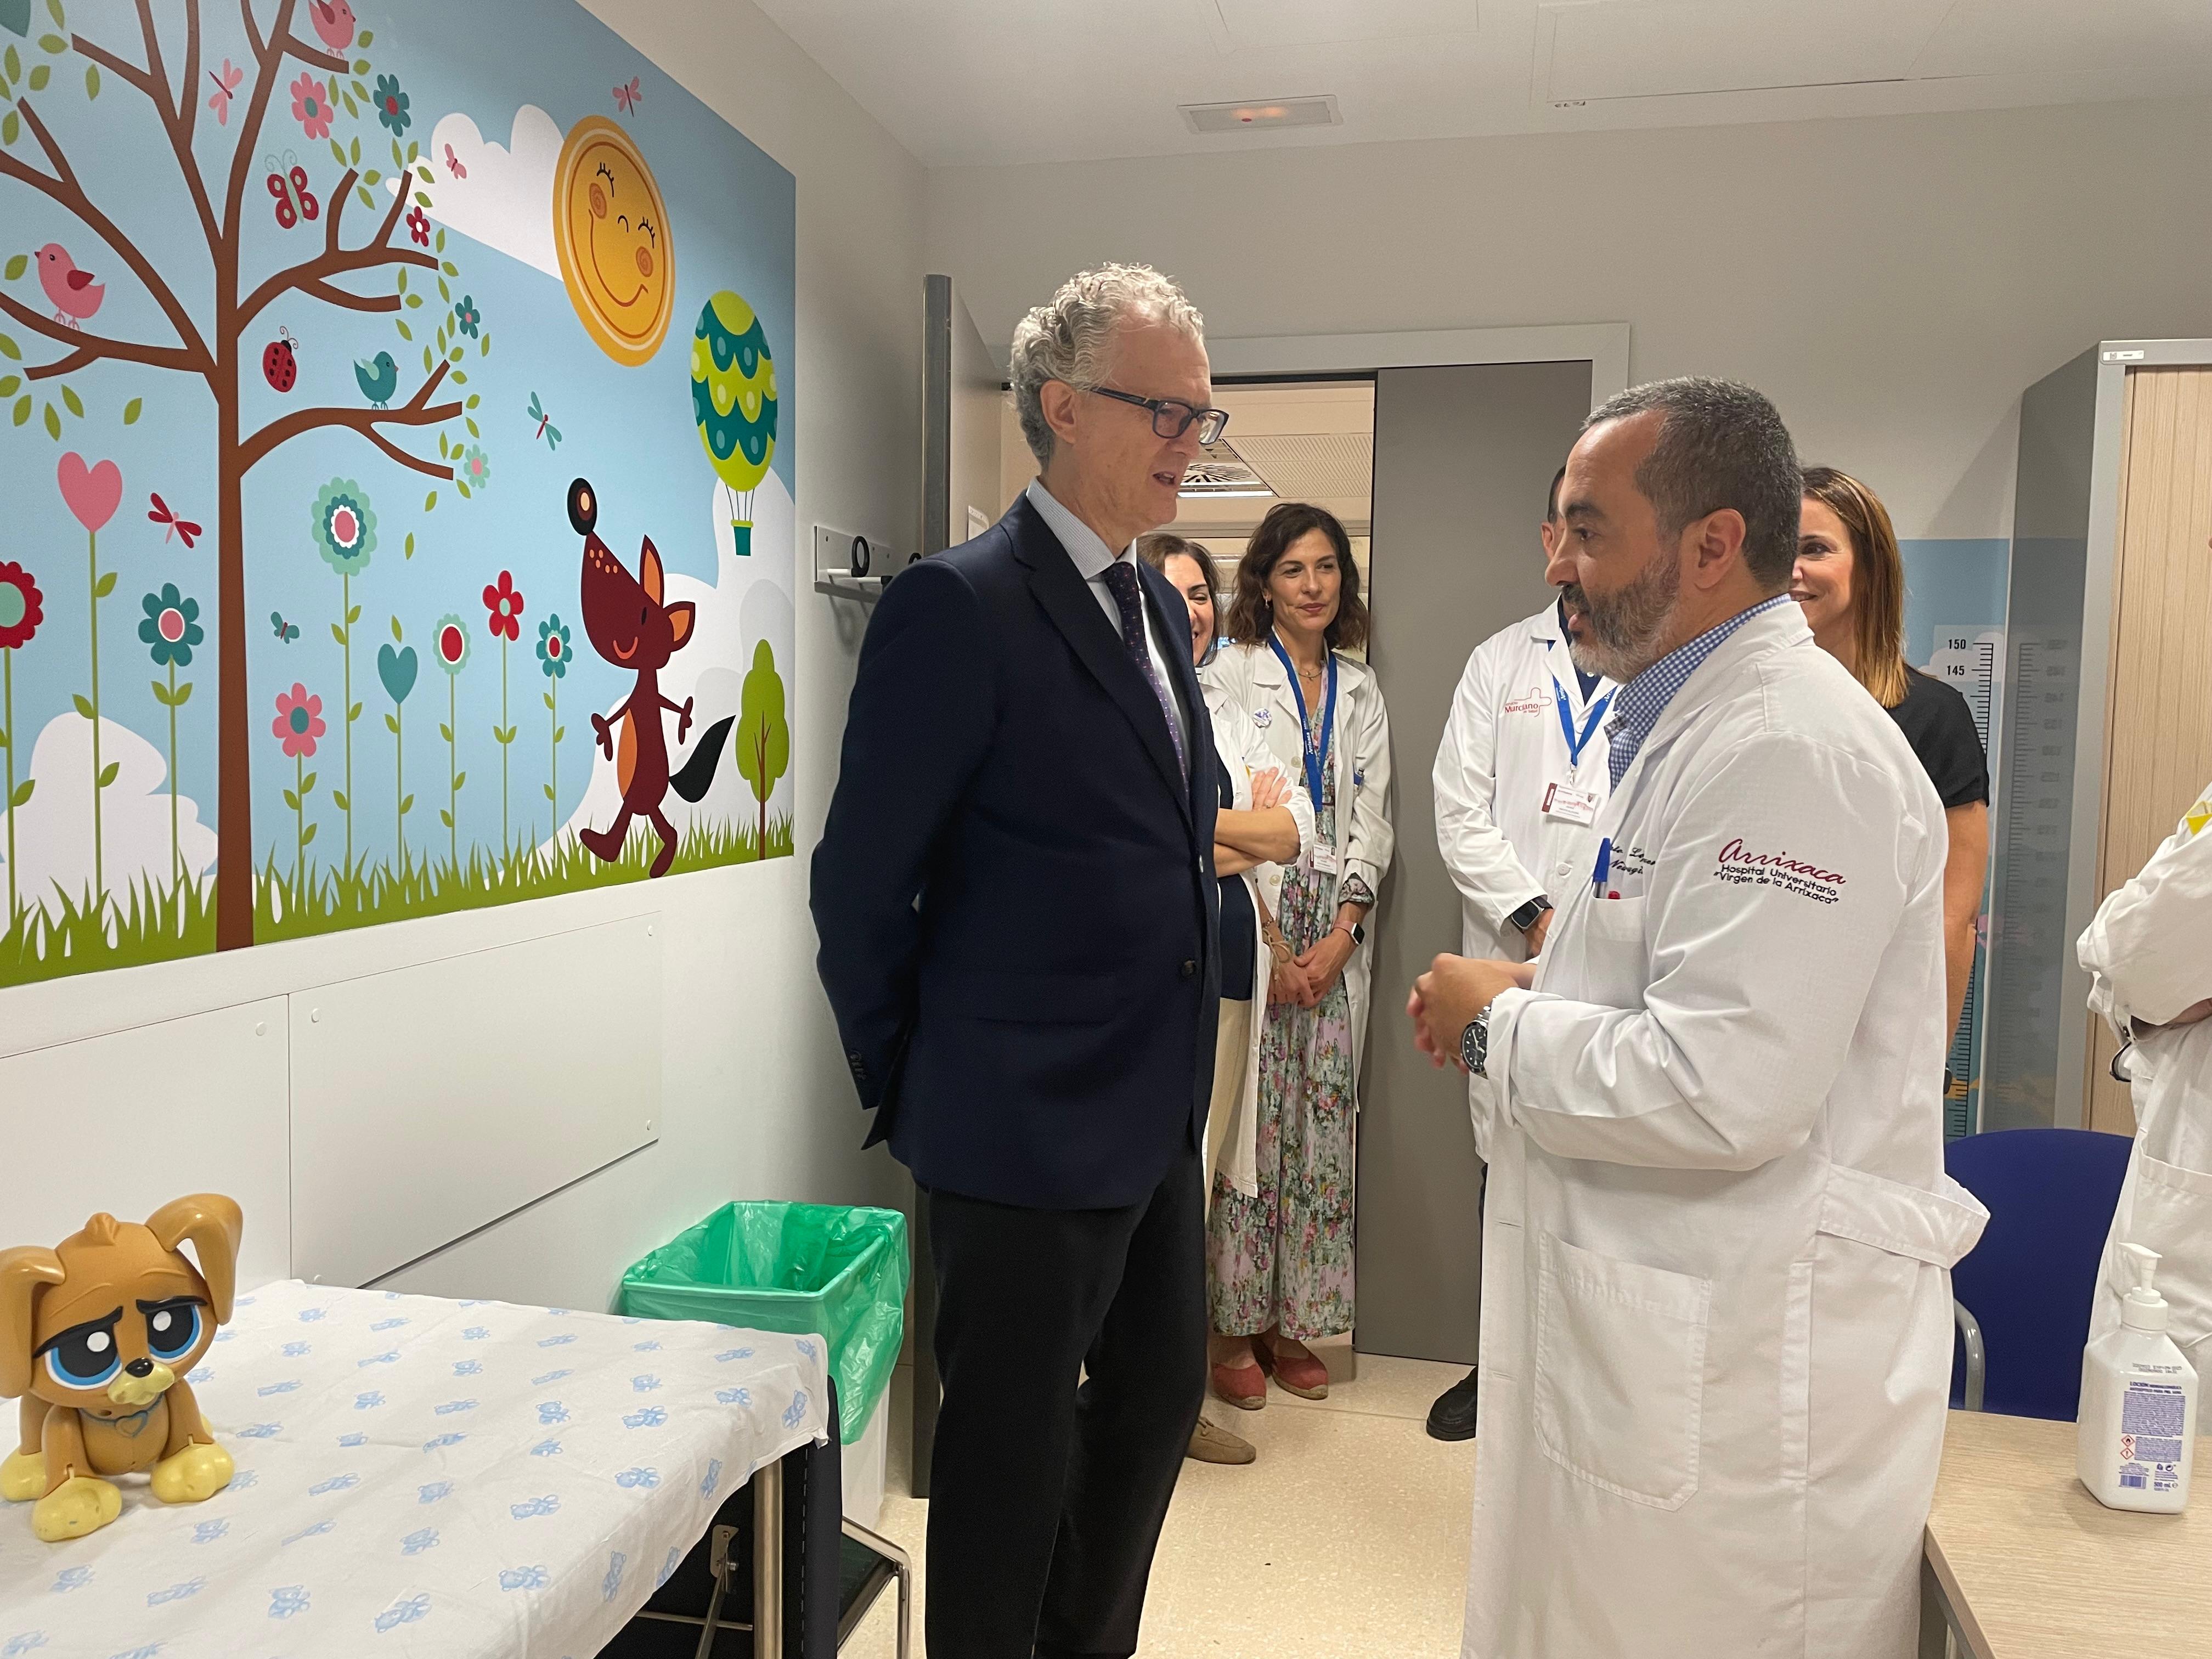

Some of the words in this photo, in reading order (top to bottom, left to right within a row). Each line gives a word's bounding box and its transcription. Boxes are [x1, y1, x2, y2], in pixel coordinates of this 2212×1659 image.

[1949, 639, 1966, 649] 150
[1947, 665, 1965, 675] 145
[1718, 838, 1846, 884] Arrixaca
[1721, 864, 1765, 876] Hospital
[1770, 868, 1837, 896] Universitario
[1773, 877, 1782, 887] la
